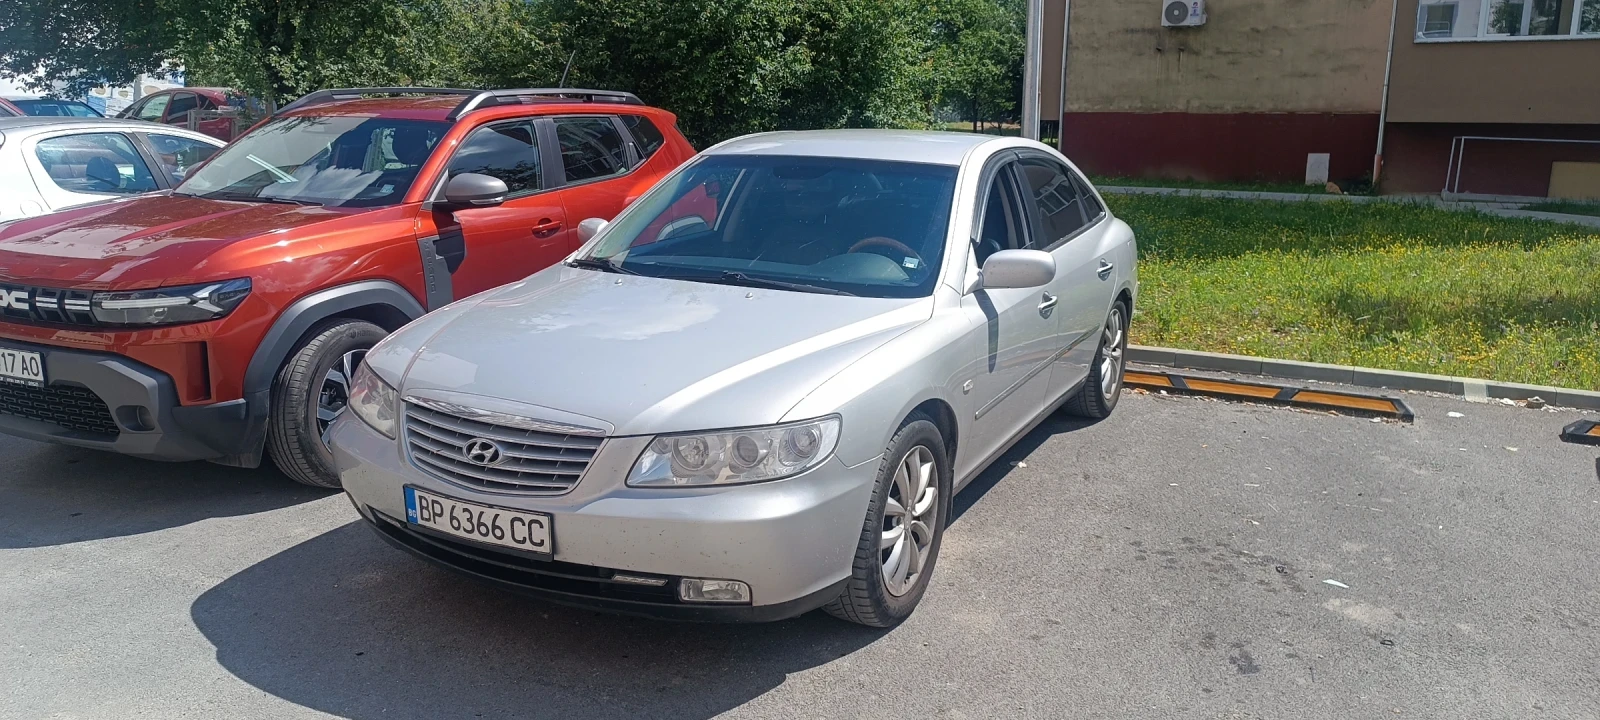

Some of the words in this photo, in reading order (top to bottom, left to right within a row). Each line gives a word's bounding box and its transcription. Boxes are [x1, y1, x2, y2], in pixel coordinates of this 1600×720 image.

[21, 355, 40, 377] AO
[408, 508, 417, 518] BG
[418, 494, 444, 524] BP
[450, 505, 505, 541] 6366
[510, 517, 545, 547] CC
